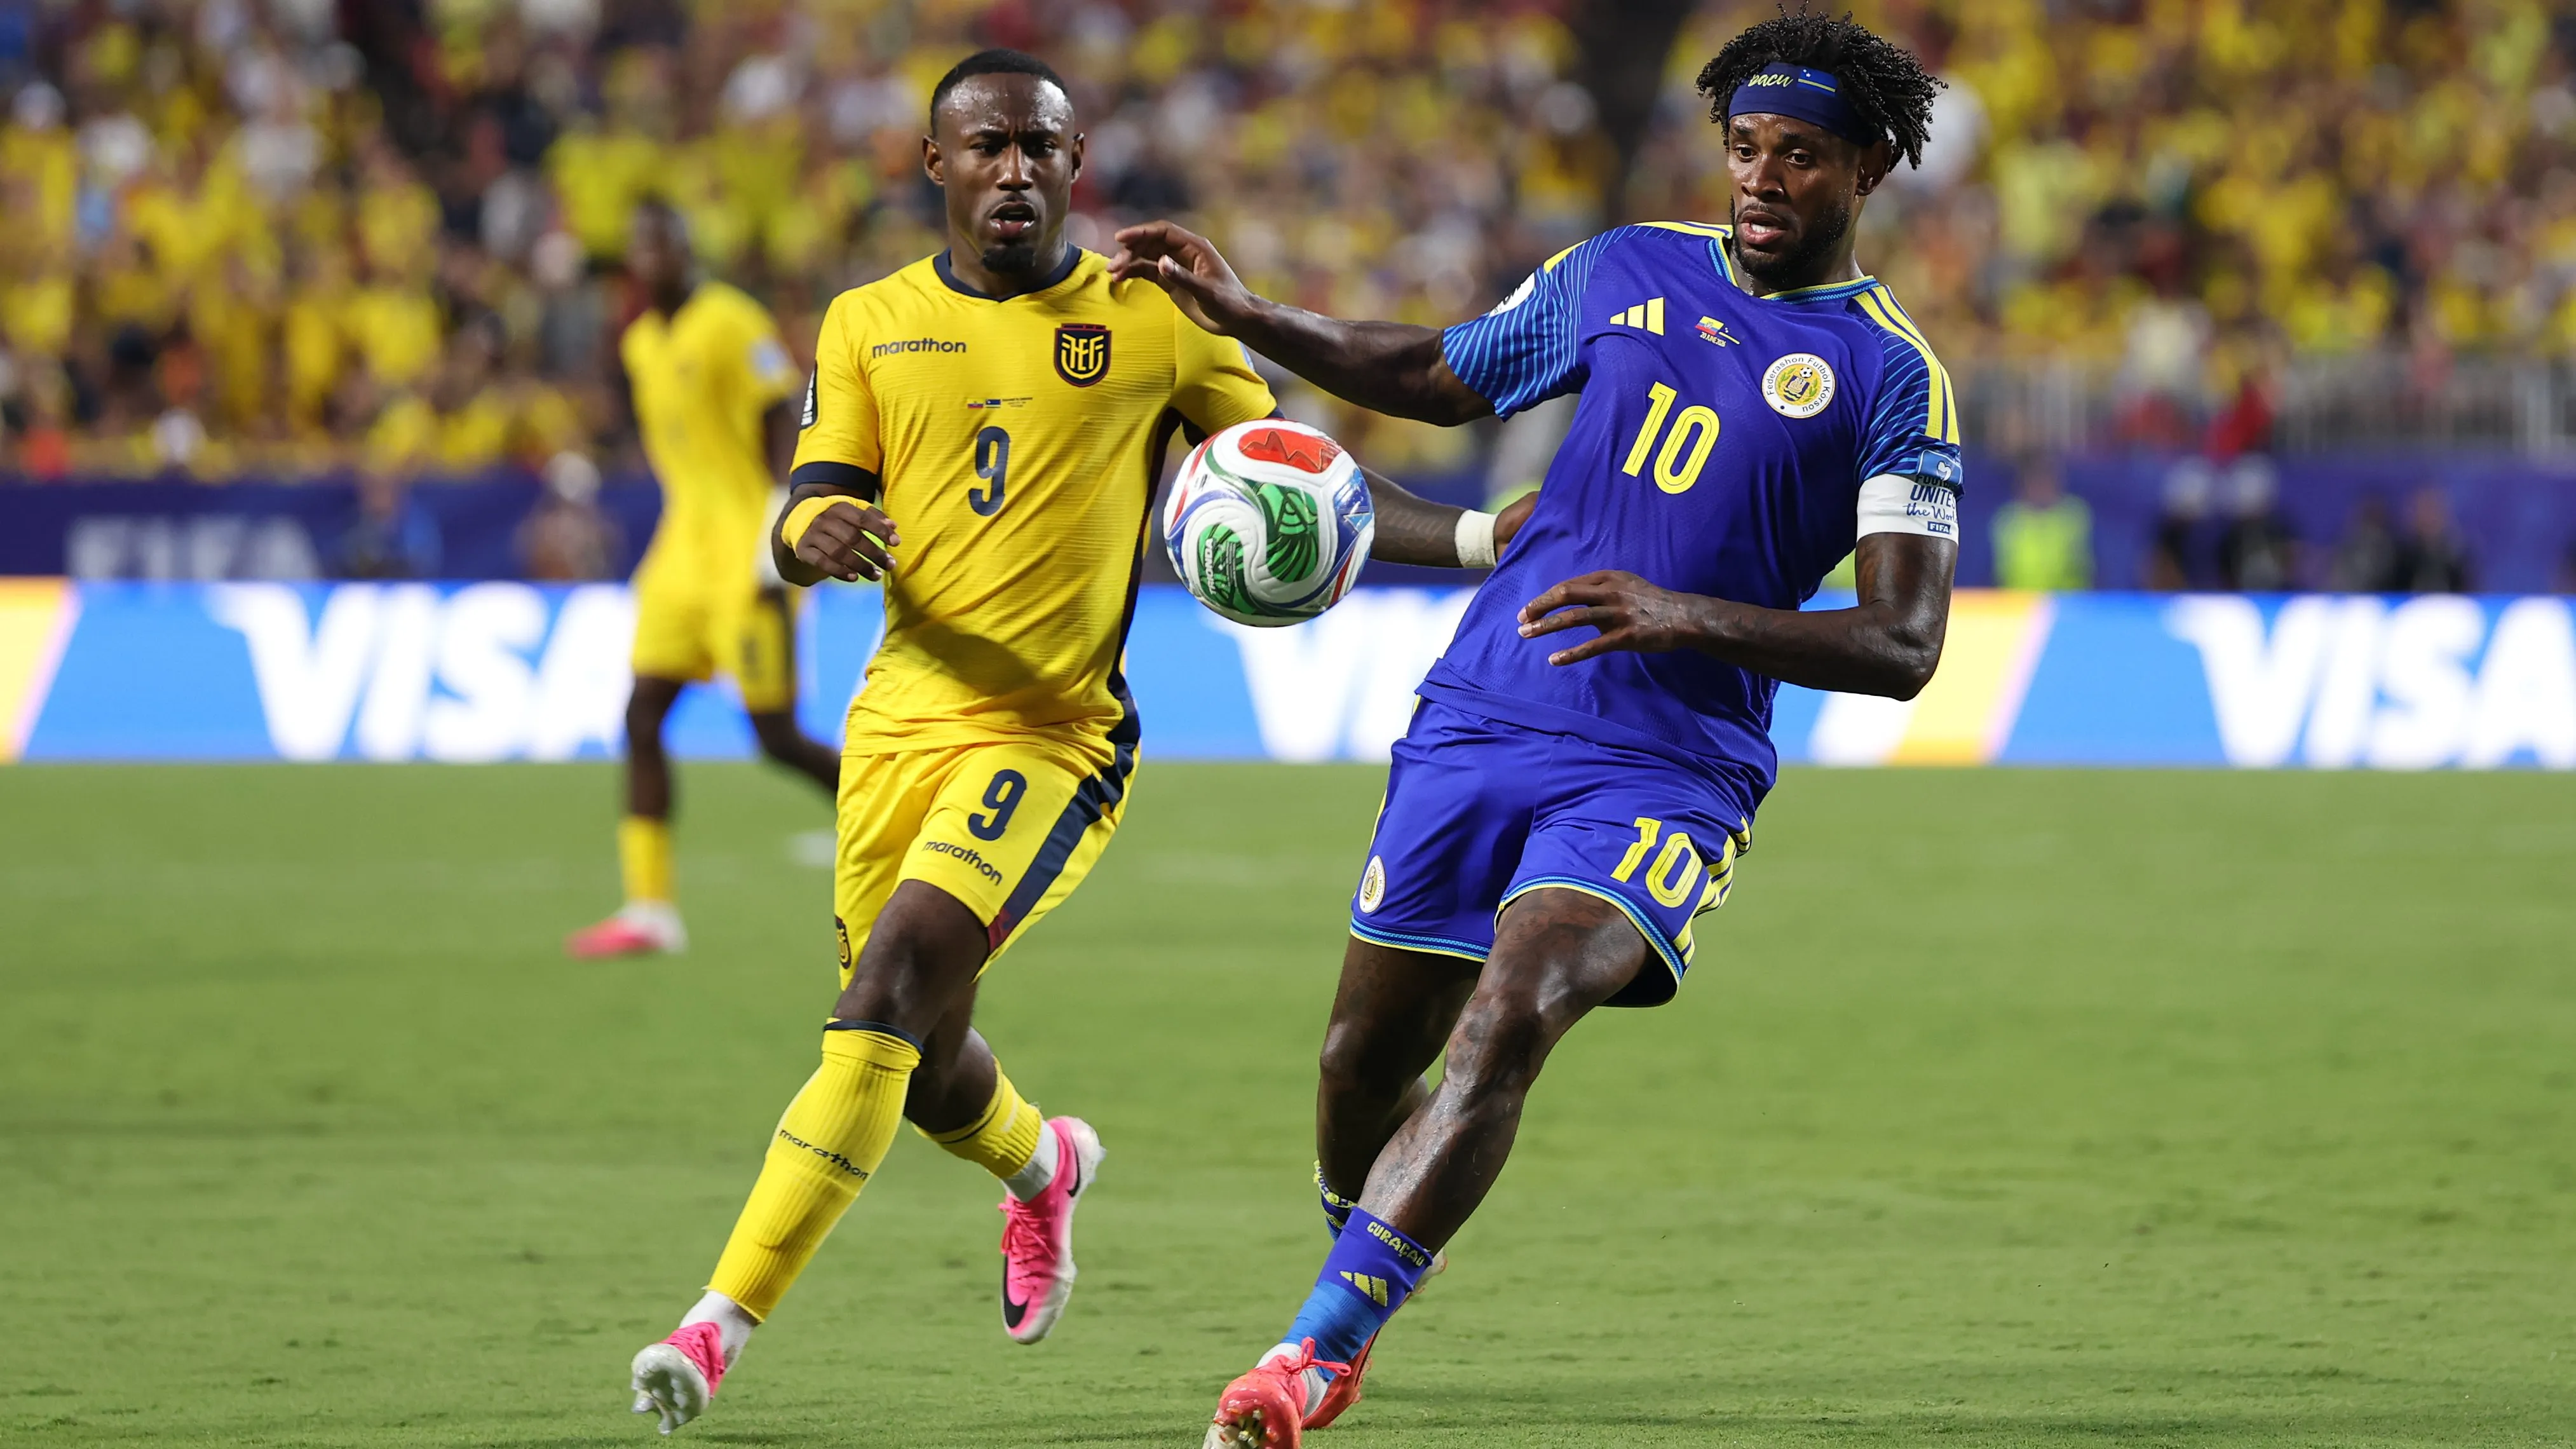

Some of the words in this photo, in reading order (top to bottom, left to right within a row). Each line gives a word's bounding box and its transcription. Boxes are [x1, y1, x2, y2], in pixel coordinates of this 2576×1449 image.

[872, 337, 966, 358] marathon
[1766, 357, 1804, 396] Federashon
[1622, 381, 1721, 494] 10
[968, 426, 1010, 516] 9
[1910, 484, 1956, 508] UNITES
[1903, 503, 1930, 516] the
[1929, 522, 1949, 533] FIFA
[1205, 538, 1216, 594] TRIONDA
[208, 581, 635, 763] VISA
[2169, 595, 2576, 768] VISA
[968, 769, 1027, 841] 9
[921, 840, 1003, 886] marathon
[1610, 817, 1703, 909] 10
[779, 1129, 870, 1181] marathon
[1367, 1221, 1425, 1267] CURAÇAO
